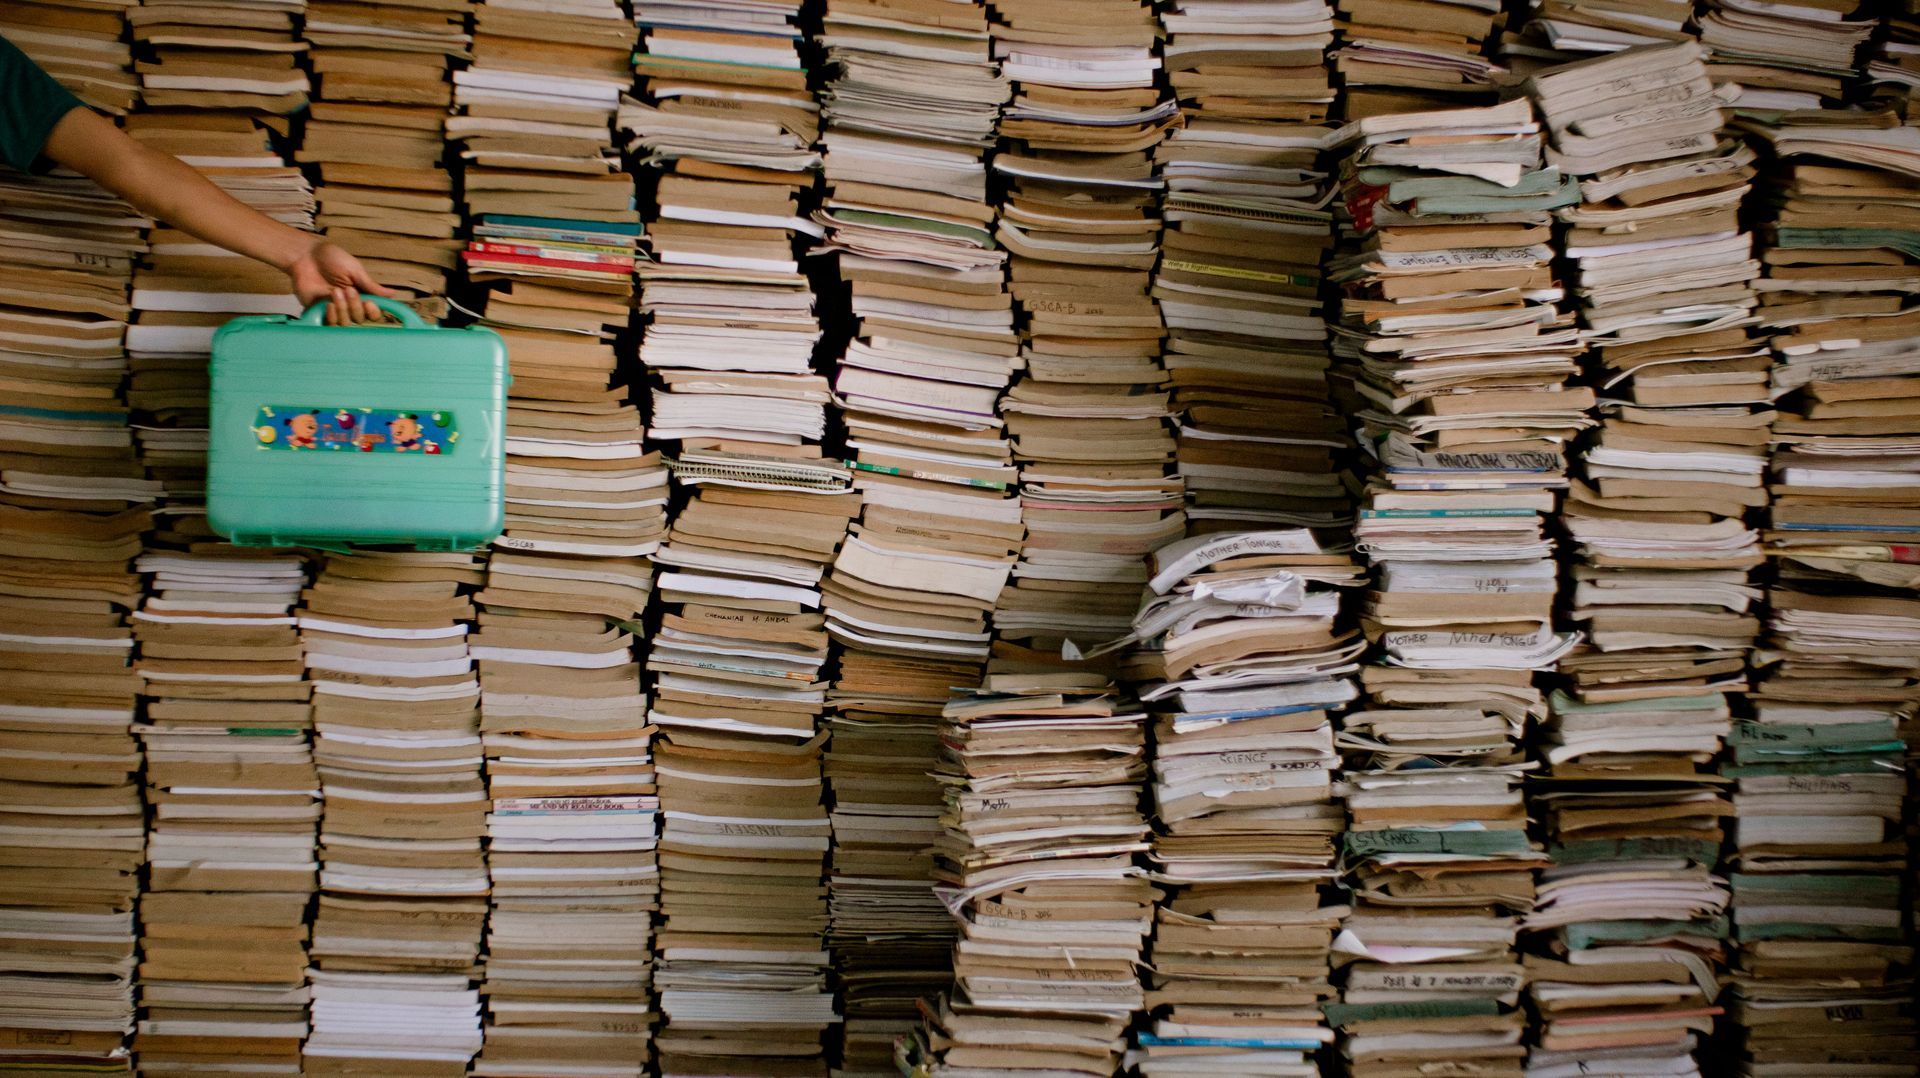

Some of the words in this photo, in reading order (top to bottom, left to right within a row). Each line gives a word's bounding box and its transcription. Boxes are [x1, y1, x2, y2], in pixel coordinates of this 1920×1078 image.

[693, 97, 743, 110] READING
[1167, 261, 1184, 269] Write
[1029, 300, 1076, 315] GSCA-B
[1195, 543, 1240, 563] MOTHER
[1240, 536, 1282, 549] TONGUE
[1386, 633, 1427, 647] MOTHER
[1219, 752, 1267, 764] SCIENCE
